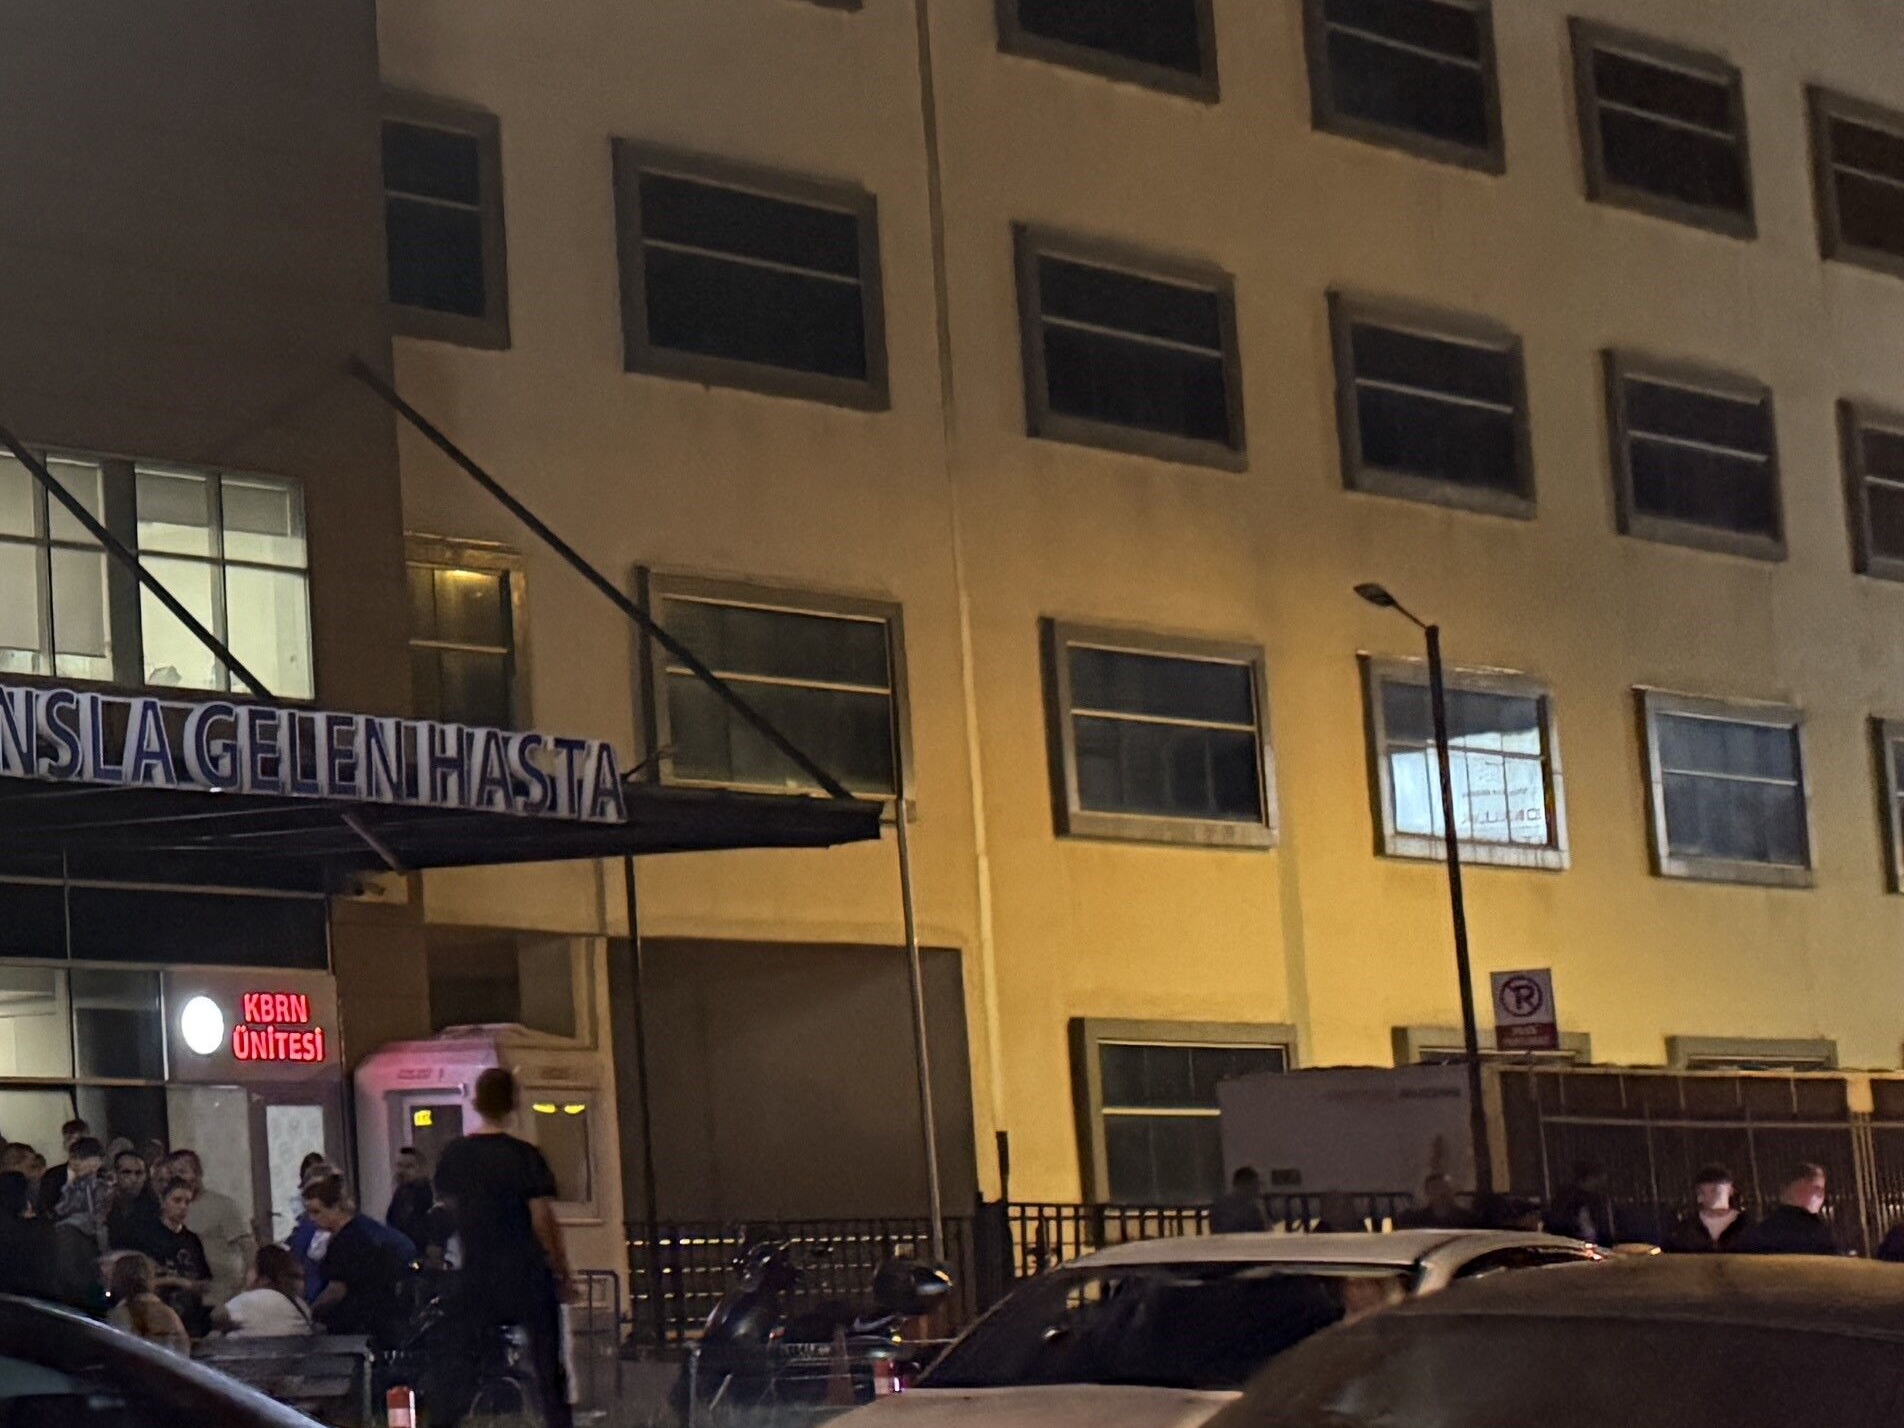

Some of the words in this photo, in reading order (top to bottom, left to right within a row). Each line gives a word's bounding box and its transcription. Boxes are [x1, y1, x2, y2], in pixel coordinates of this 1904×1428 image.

[186, 702, 407, 801] GELEN
[428, 722, 627, 824] HASTA
[243, 992, 308, 1023] KBRN
[233, 1025, 323, 1062] ÜNİTESİ
